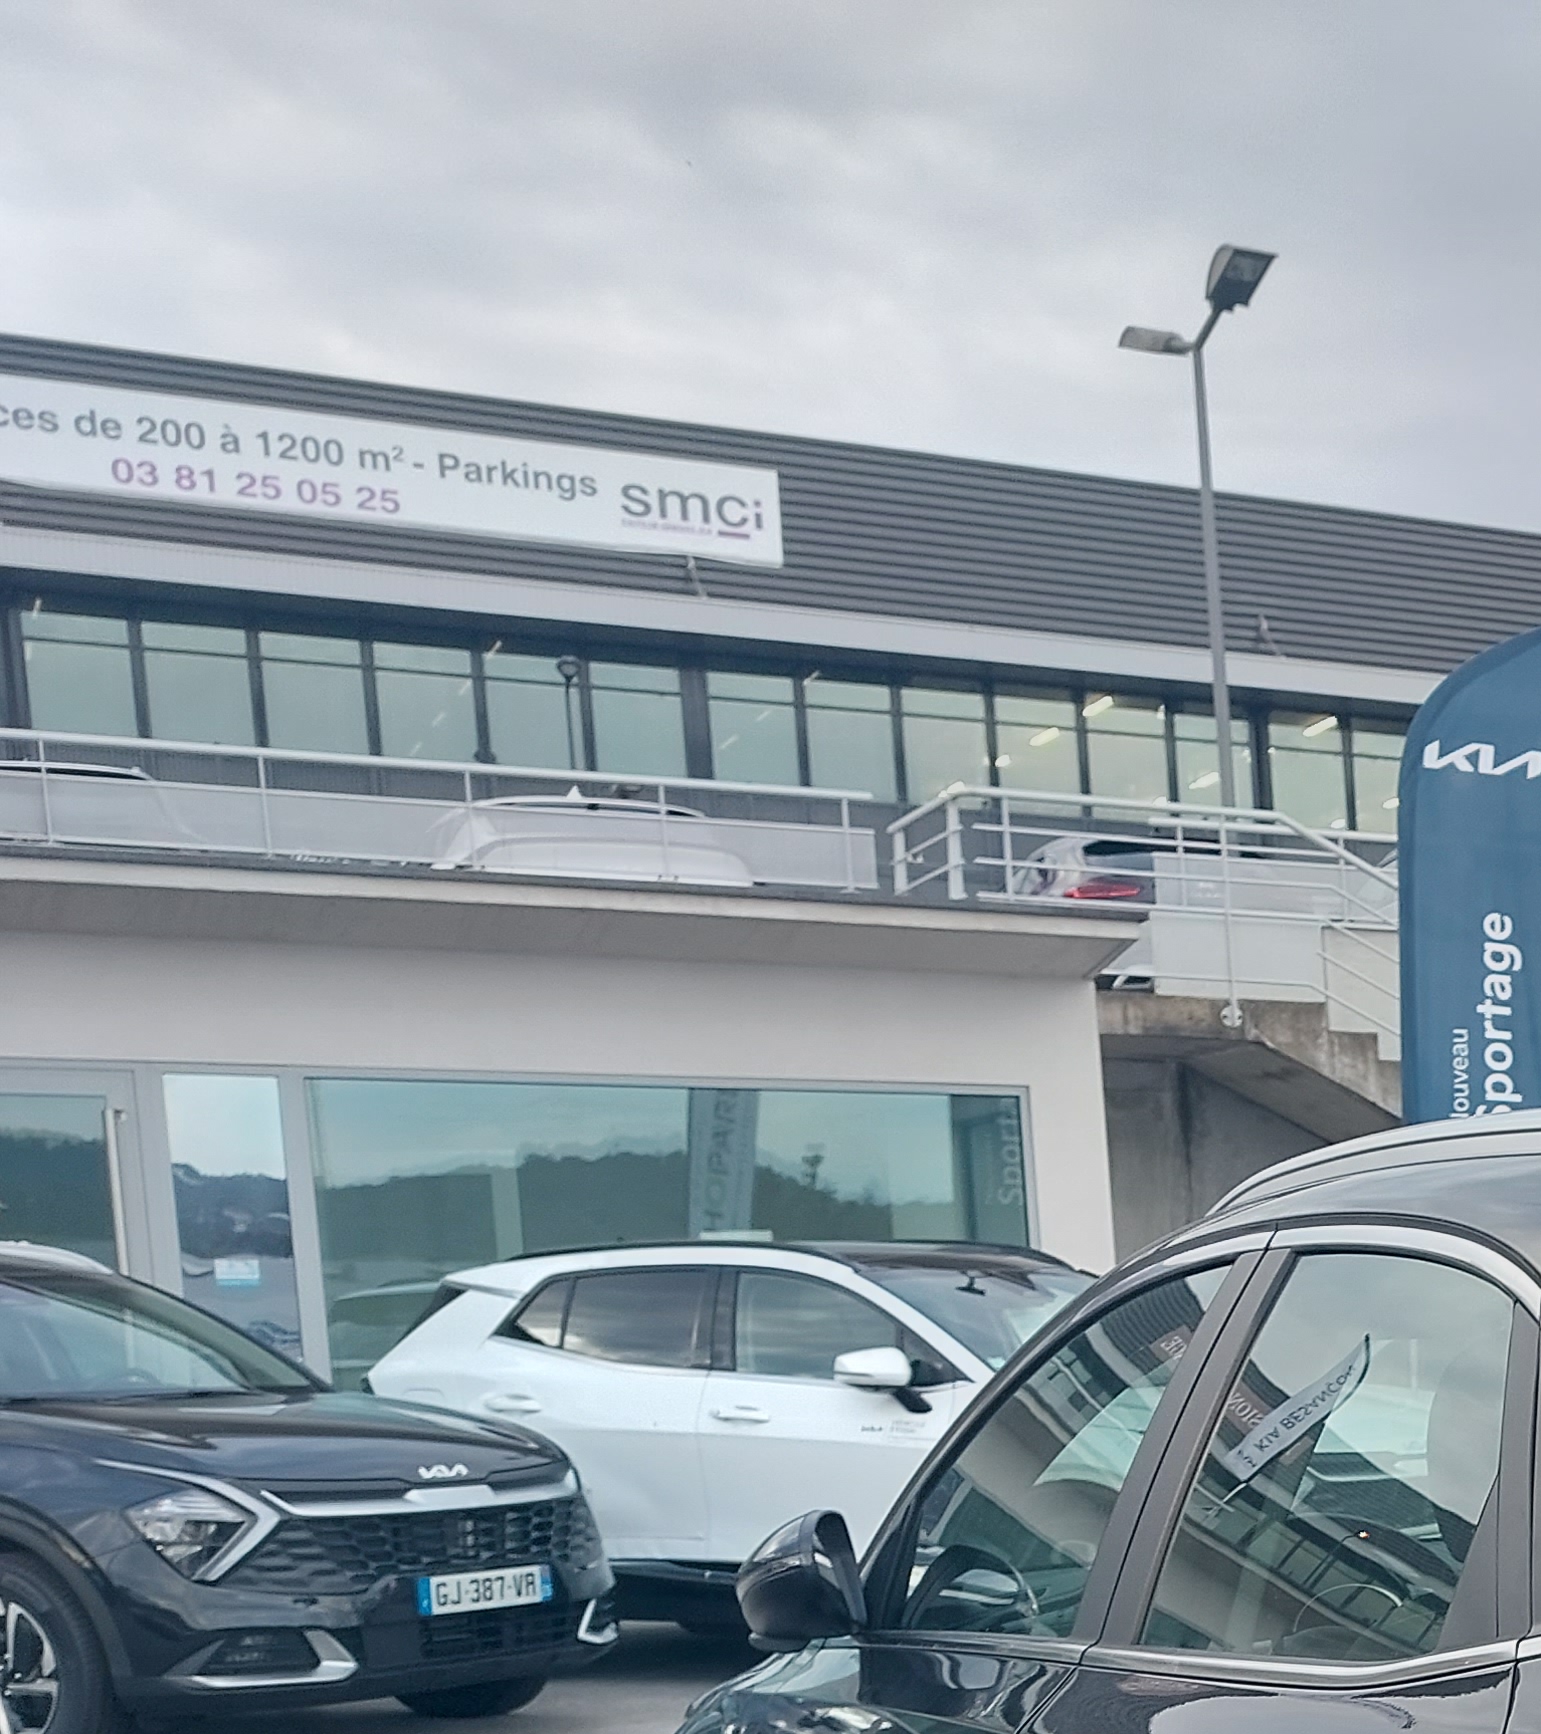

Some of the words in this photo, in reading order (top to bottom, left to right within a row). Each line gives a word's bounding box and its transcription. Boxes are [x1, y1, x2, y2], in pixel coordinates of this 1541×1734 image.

[74, 409, 122, 440] de
[136, 416, 206, 450] 200
[220, 424, 241, 455] à
[256, 430, 344, 468] 1200
[438, 453, 598, 501] Parkings
[111, 457, 159, 487] 03
[175, 465, 217, 494] 81
[235, 471, 282, 500] 25
[296, 479, 341, 508] 05
[356, 486, 401, 514] 25
